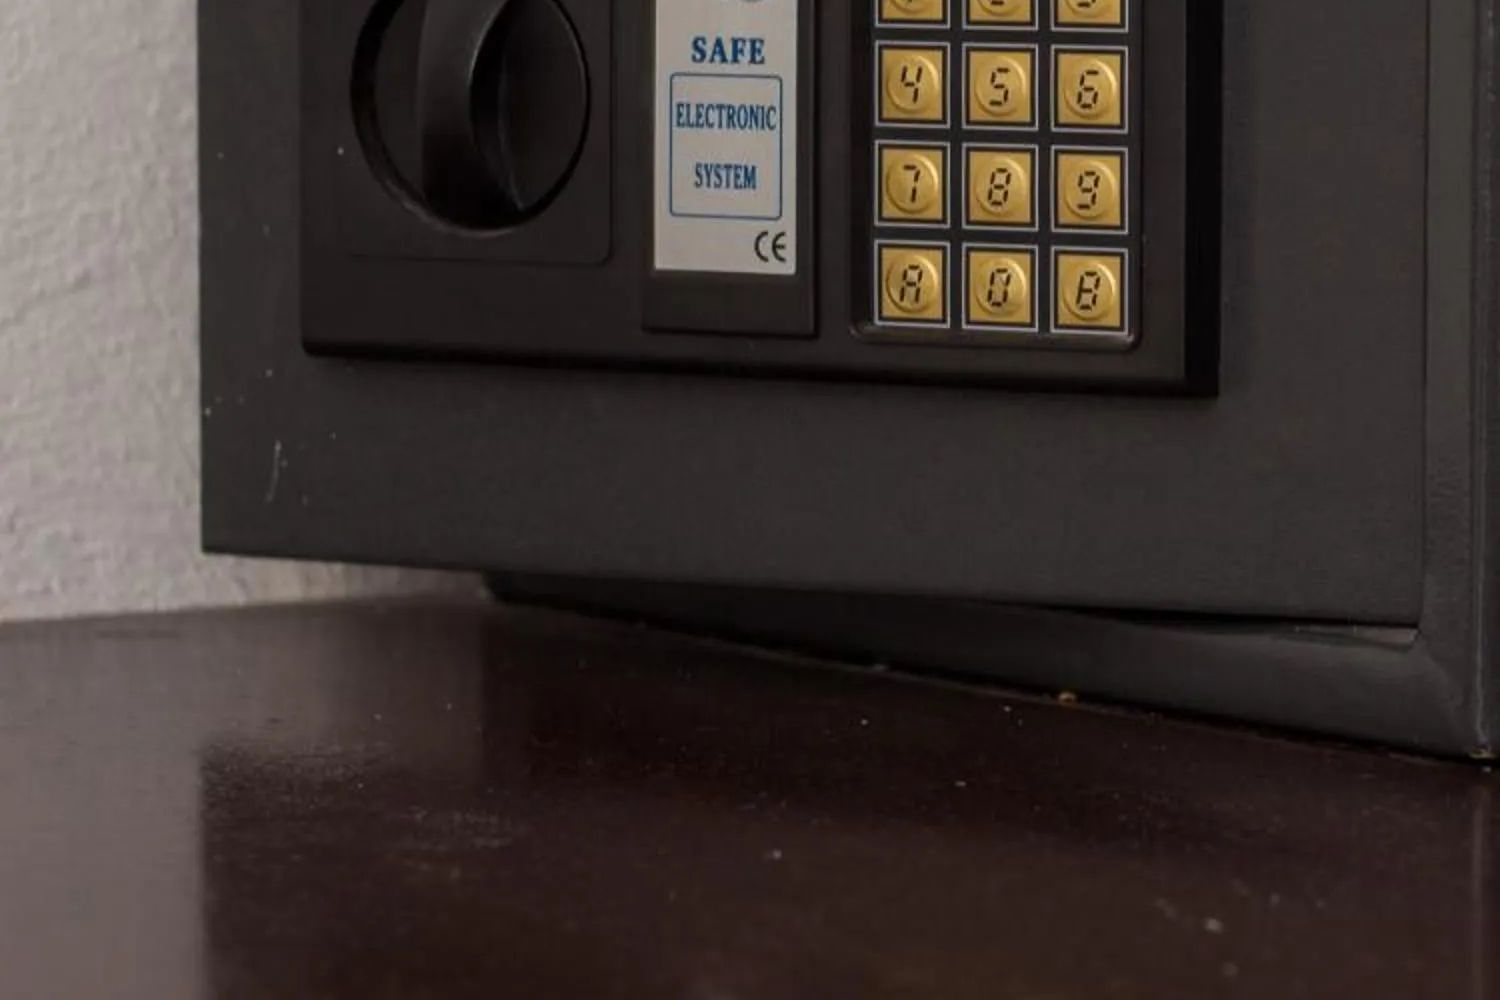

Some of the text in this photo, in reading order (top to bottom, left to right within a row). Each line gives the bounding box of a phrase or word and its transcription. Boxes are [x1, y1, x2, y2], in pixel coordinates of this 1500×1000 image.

[691, 36, 766, 65] SAFE
[900, 65, 923, 104] 4
[988, 67, 1011, 107] 5
[1076, 69, 1100, 110] 6
[676, 103, 777, 131] ELECTRONIC
[694, 162, 758, 190] SYSTEM
[902, 164, 921, 204] 7
[987, 167, 1012, 207] 8
[1076, 170, 1101, 210] 9
[986, 267, 1012, 308] 0
